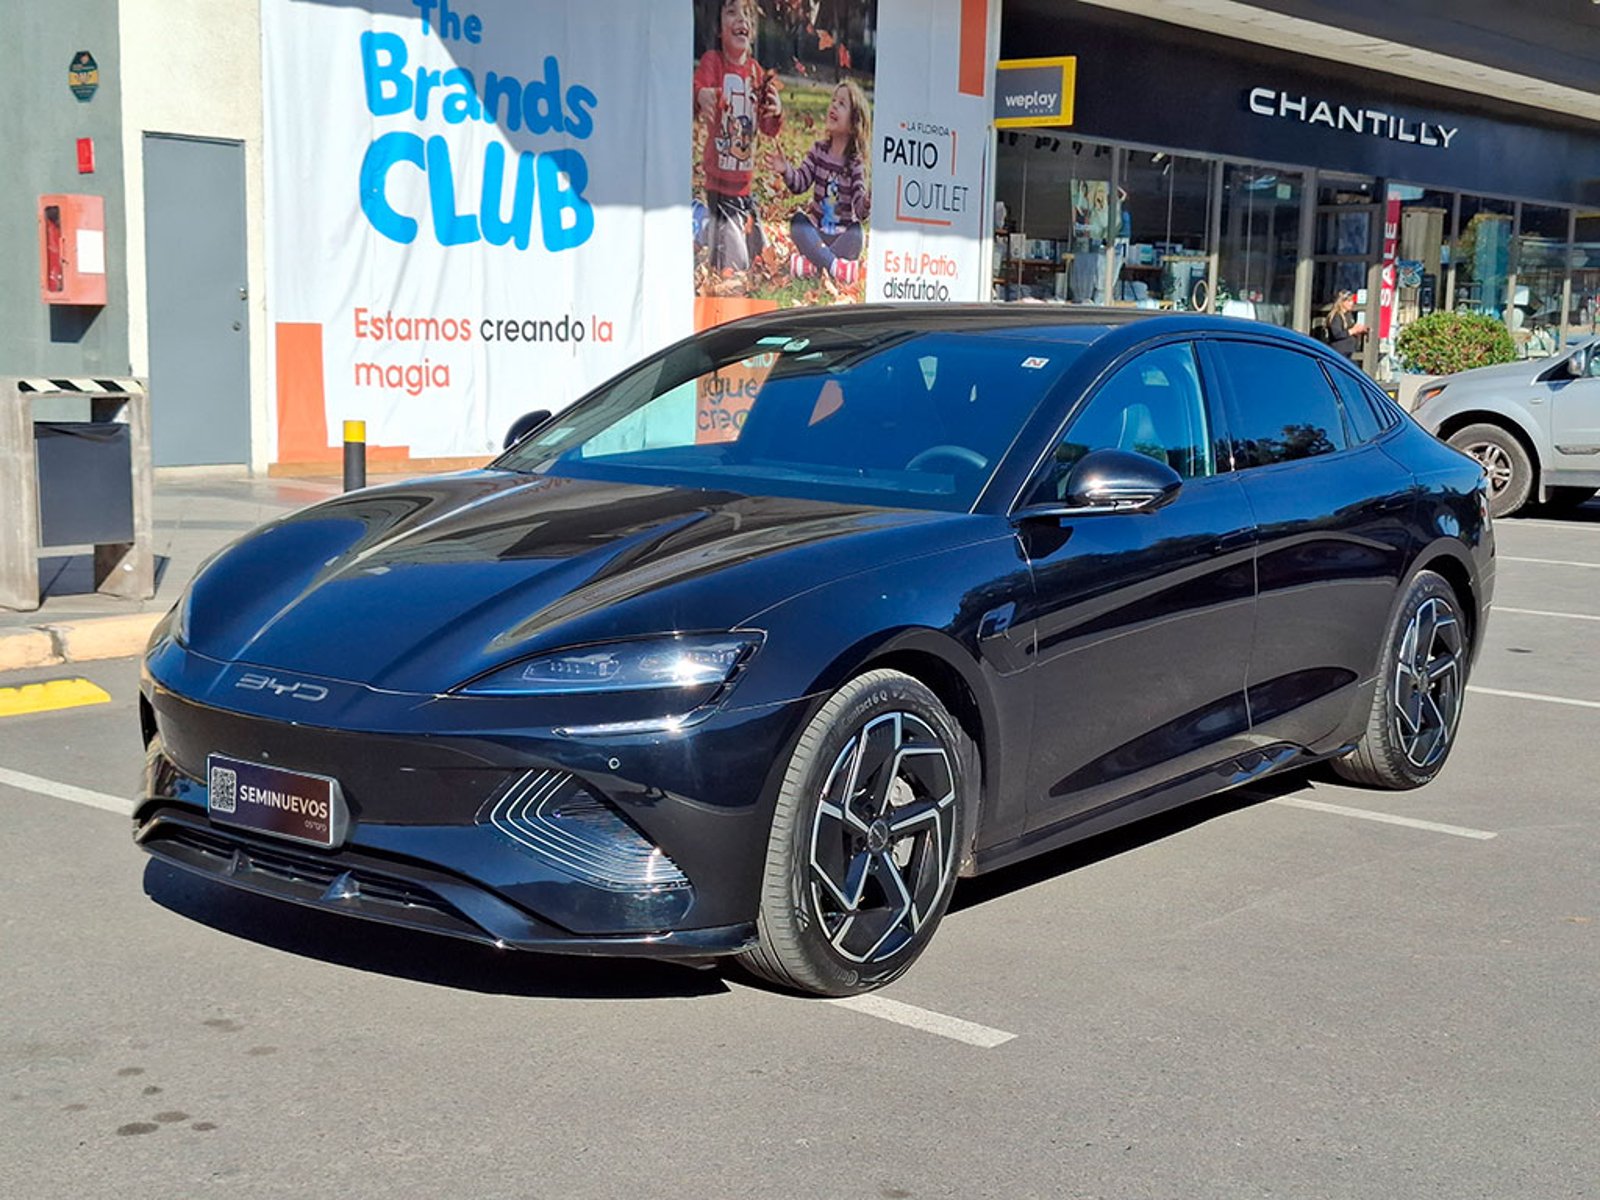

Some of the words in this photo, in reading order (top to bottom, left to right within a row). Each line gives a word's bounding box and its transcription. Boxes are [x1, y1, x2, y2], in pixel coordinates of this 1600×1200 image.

[412, 0, 482, 43] The
[360, 30, 598, 140] Brands
[1005, 90, 1057, 109] weplay
[917, 122, 950, 136] FLORIDA
[1249, 86, 1459, 149] CHANTILLY
[882, 136, 938, 169] PATIO
[359, 131, 595, 252] CLUB
[904, 180, 969, 212] OUTLET
[884, 250, 901, 273] Es
[904, 251, 918, 274] tu
[920, 253, 959, 280] Patio,
[1379, 222, 1398, 307] SALE
[354, 307, 472, 342] Estamos
[479, 314, 586, 343] creando
[591, 315, 613, 342] la
[354, 357, 451, 397] magia
[234, 672, 330, 701] BYD
[239, 785, 329, 819] SEMINUEVOS
